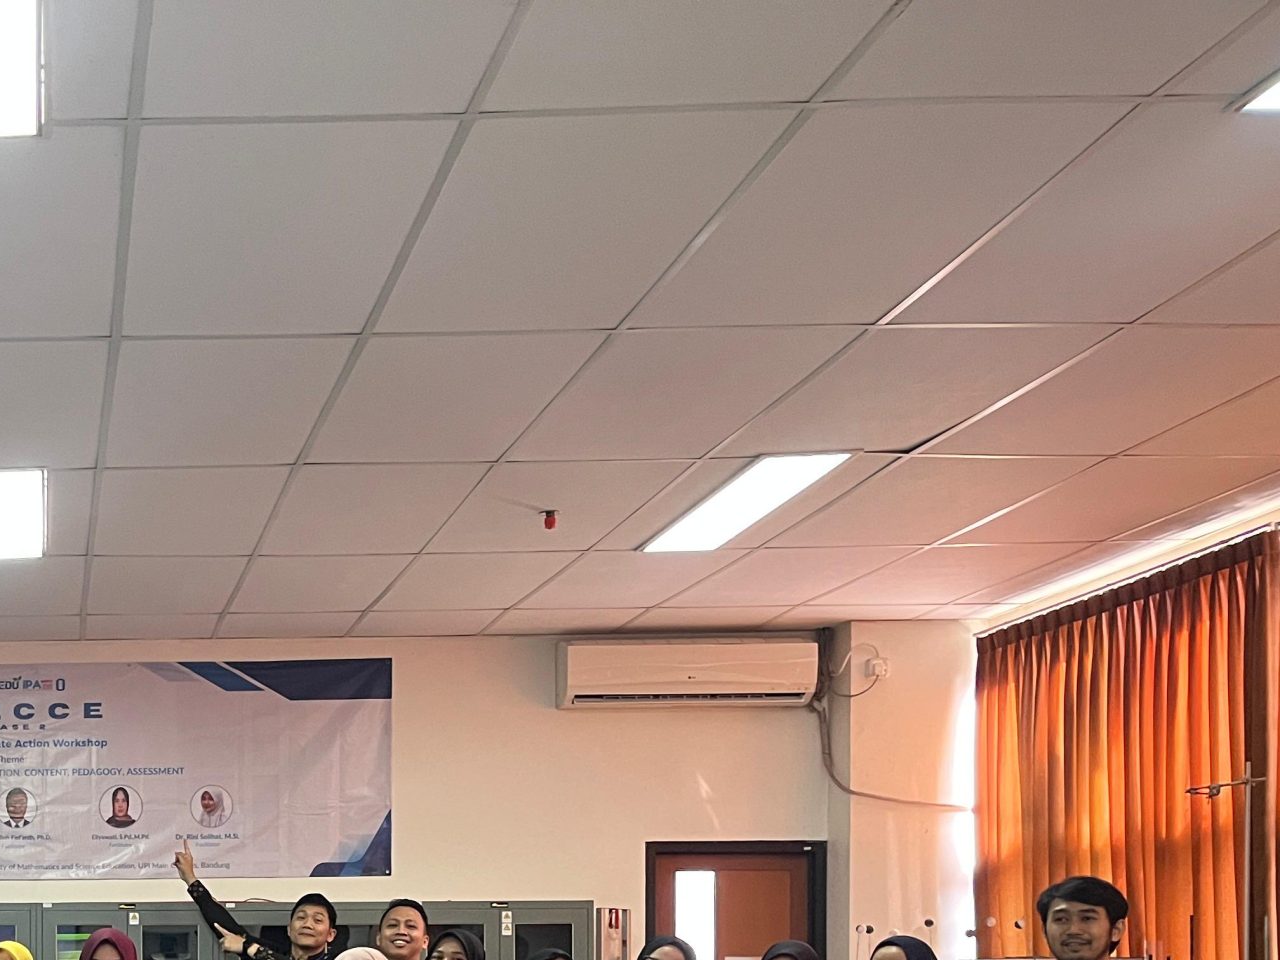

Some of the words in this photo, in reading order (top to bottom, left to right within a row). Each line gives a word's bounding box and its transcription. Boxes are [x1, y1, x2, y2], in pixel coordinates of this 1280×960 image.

[14, 739, 50, 748] Action
[53, 738, 108, 750] Workshop
[126, 767, 185, 776] ASSESSMENT
[200, 861, 231, 870] Bandung
